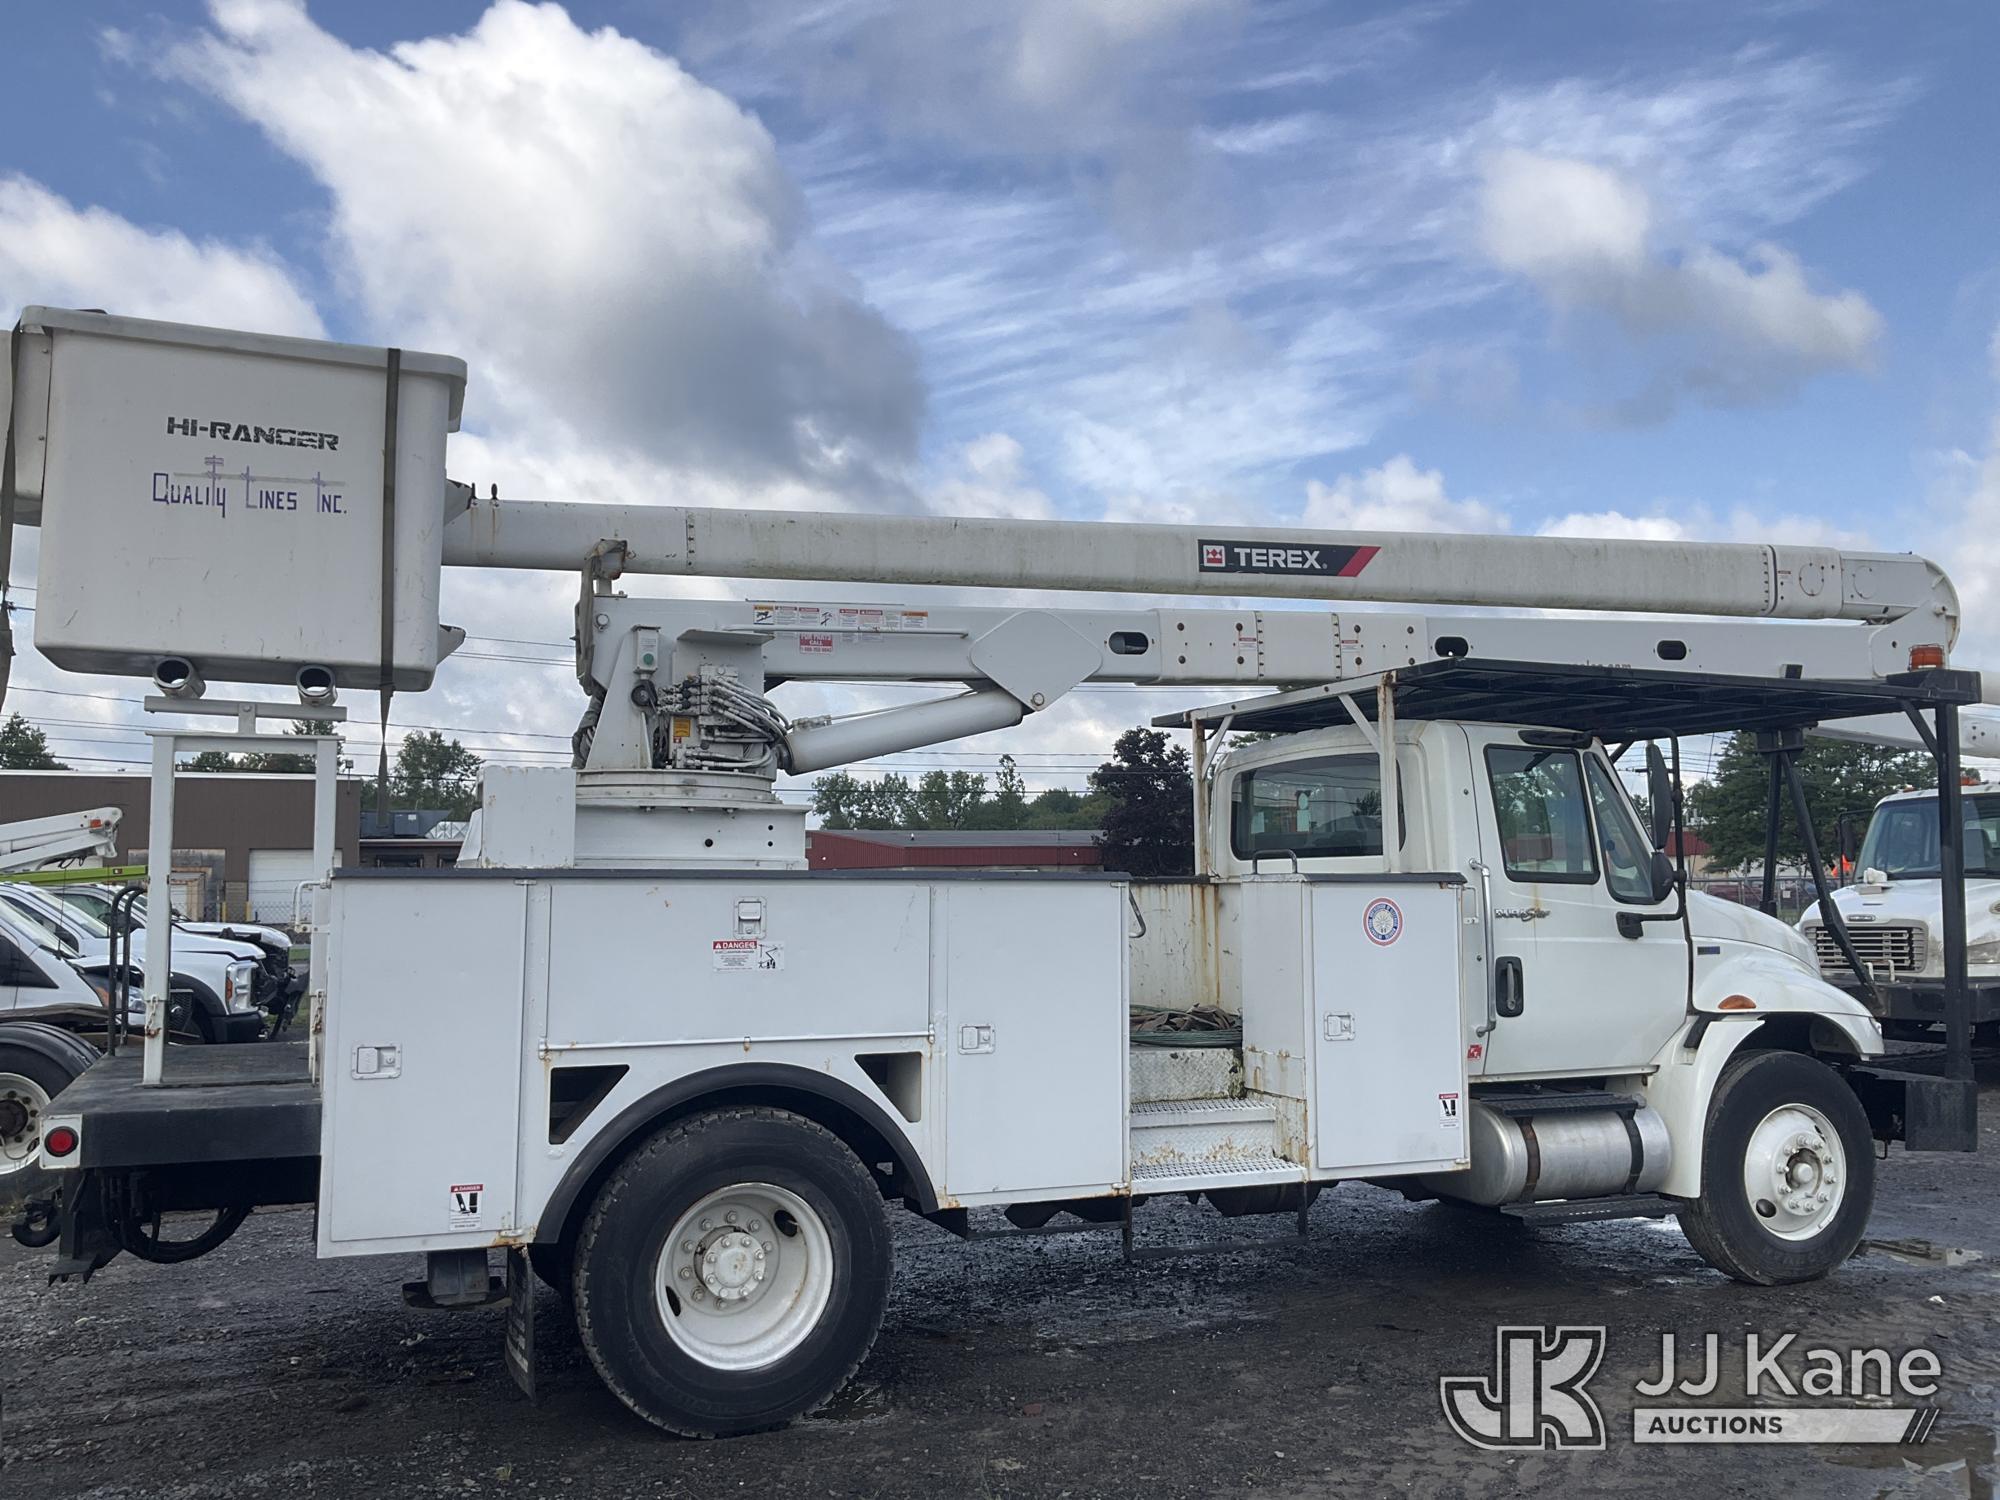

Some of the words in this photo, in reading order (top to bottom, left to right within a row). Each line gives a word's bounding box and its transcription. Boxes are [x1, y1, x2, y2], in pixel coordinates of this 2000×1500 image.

[167, 416, 339, 451] HI-RANGER
[246, 466, 298, 511] LINES
[316, 471, 347, 514] INC.
[1233, 547, 1322, 569] TEREX
[722, 941, 756, 949] DANGER
